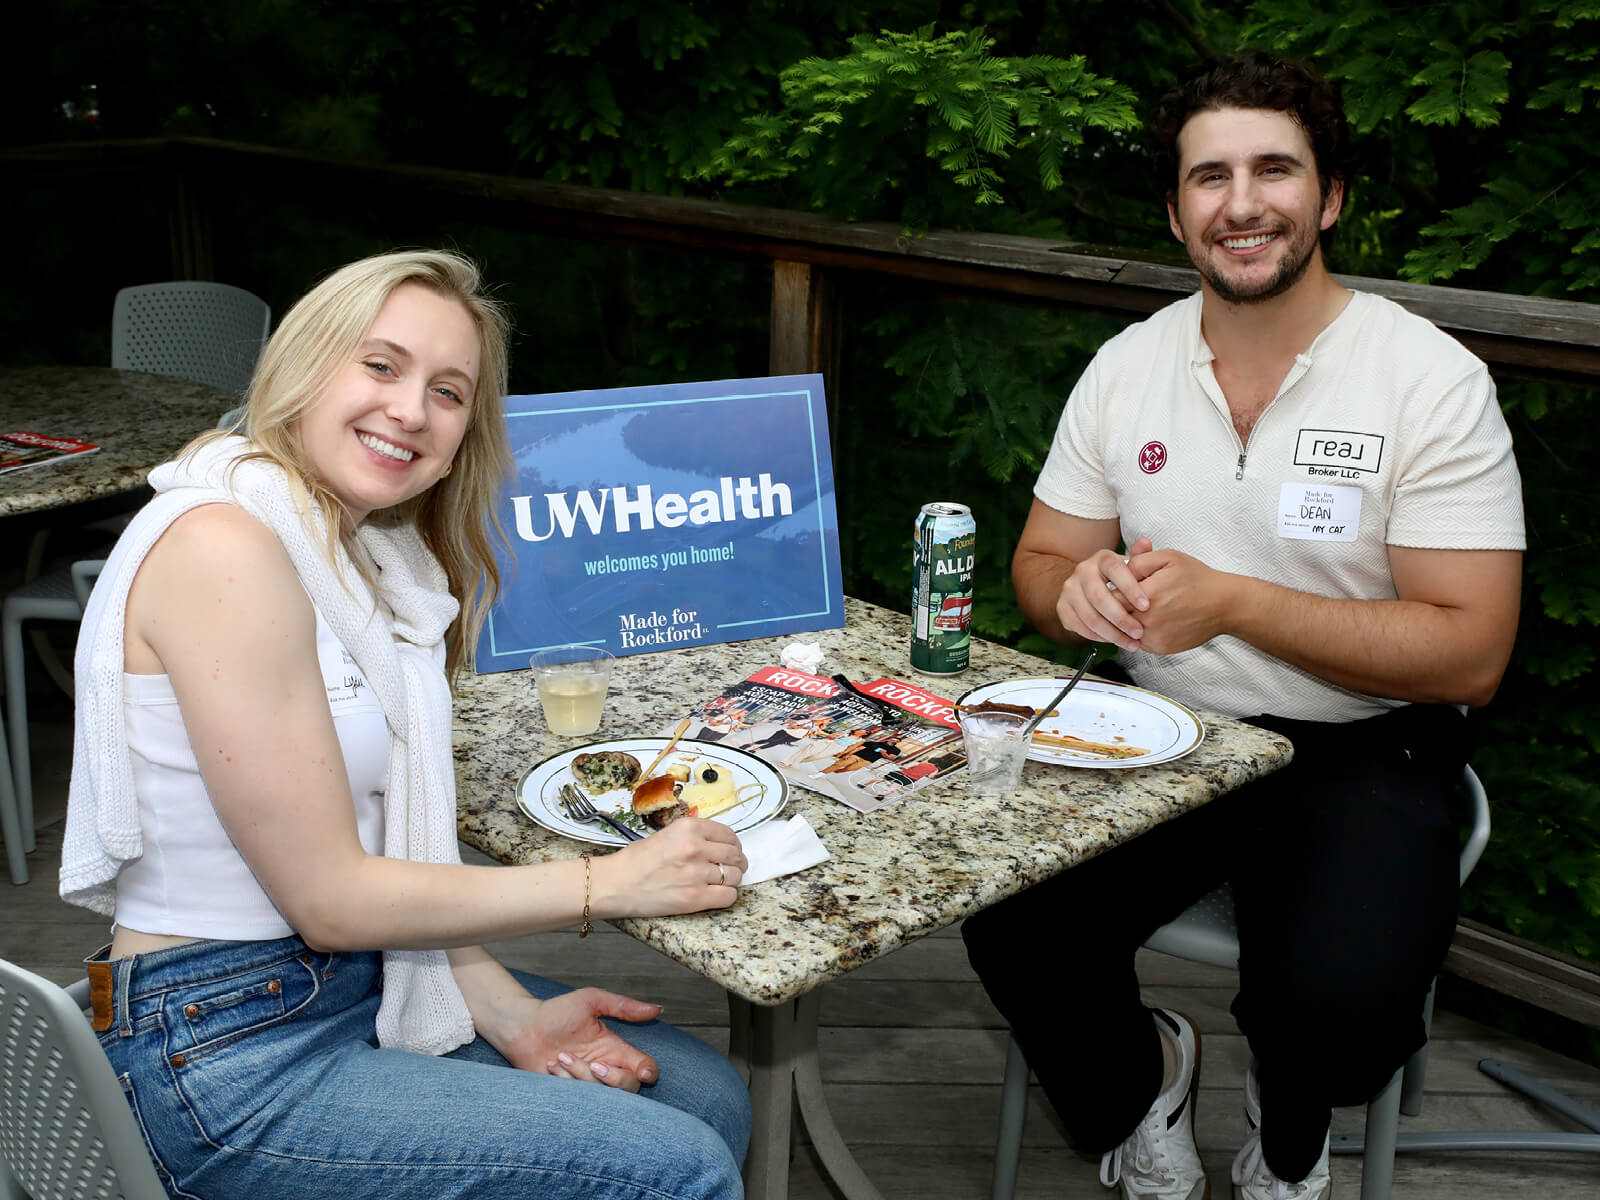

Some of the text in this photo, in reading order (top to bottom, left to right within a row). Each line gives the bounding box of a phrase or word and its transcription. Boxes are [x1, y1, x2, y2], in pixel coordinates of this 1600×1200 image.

[1308, 466, 1361, 479] Broker LLC
[1300, 504, 1331, 520] DEAN
[1312, 525, 1346, 534] MY CAT
[584, 541, 735, 576] welcomes you home!
[935, 557, 965, 576] ALL
[959, 572, 972, 582] IPA
[618, 608, 697, 632] Made for
[620, 623, 703, 648] Rockford
[793, 695, 808, 703] TO
[869, 683, 957, 723] ROCKFO
